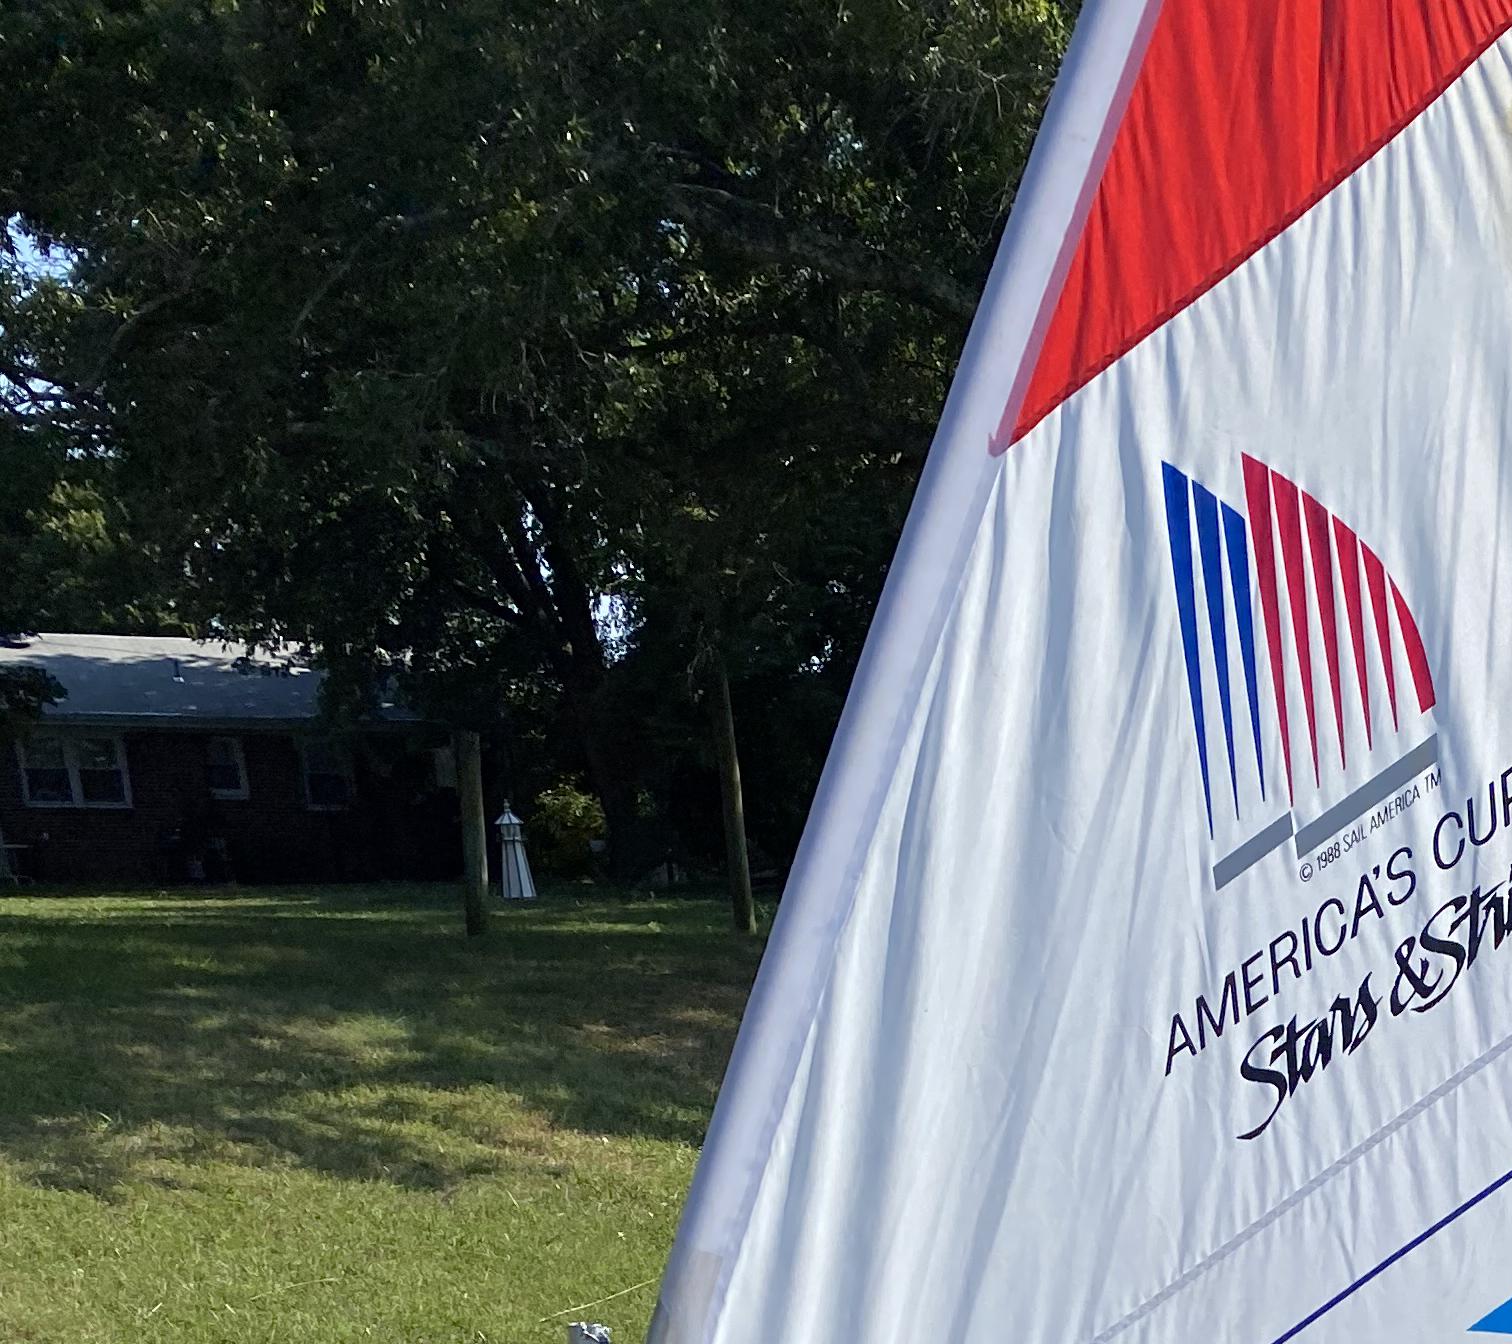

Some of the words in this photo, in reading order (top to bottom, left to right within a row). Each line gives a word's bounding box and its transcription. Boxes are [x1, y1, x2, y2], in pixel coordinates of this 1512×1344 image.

[1316, 842, 1341, 871] 1988
[1342, 824, 1368, 852] SAIL
[1370, 785, 1421, 834] AMERICA
[1165, 847, 1418, 1076] AMERICA'S
[1236, 971, 1384, 1141] Stars
